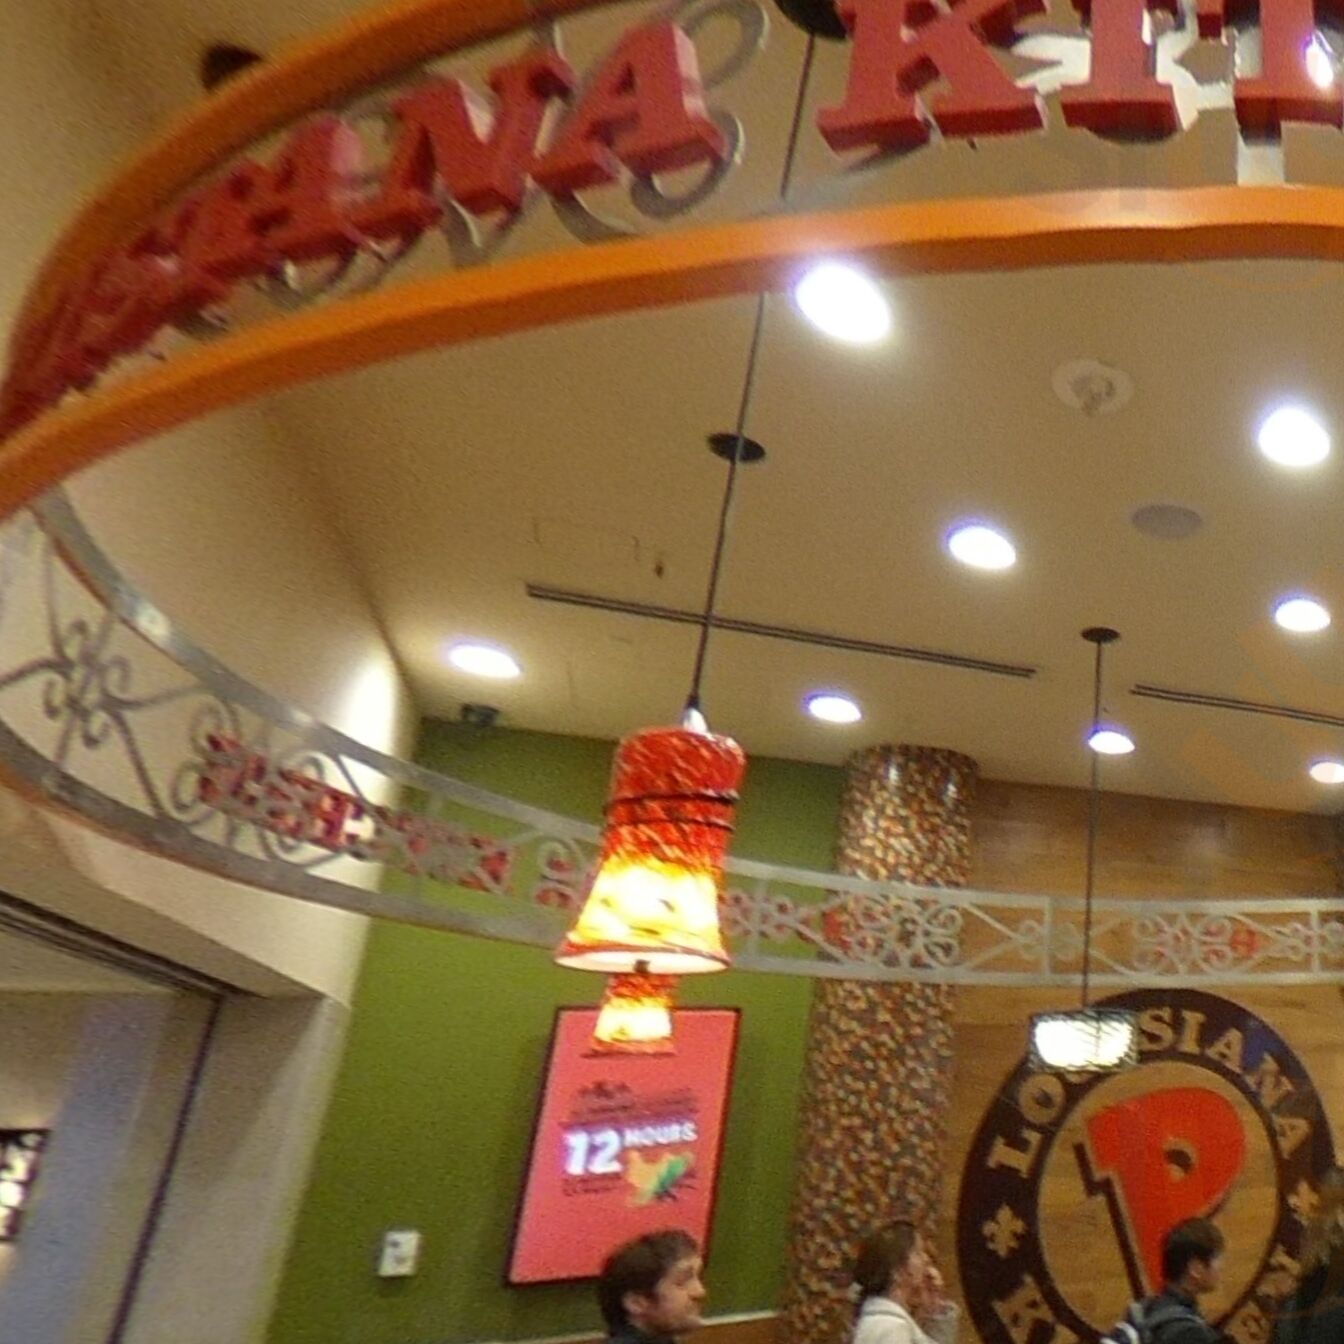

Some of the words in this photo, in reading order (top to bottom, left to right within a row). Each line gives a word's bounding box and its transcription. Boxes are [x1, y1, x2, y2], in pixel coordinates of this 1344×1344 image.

[563, 1129, 623, 1175] 12
[623, 1120, 698, 1147] HOURS
[987, 1006, 1313, 1179] LOSIANA
